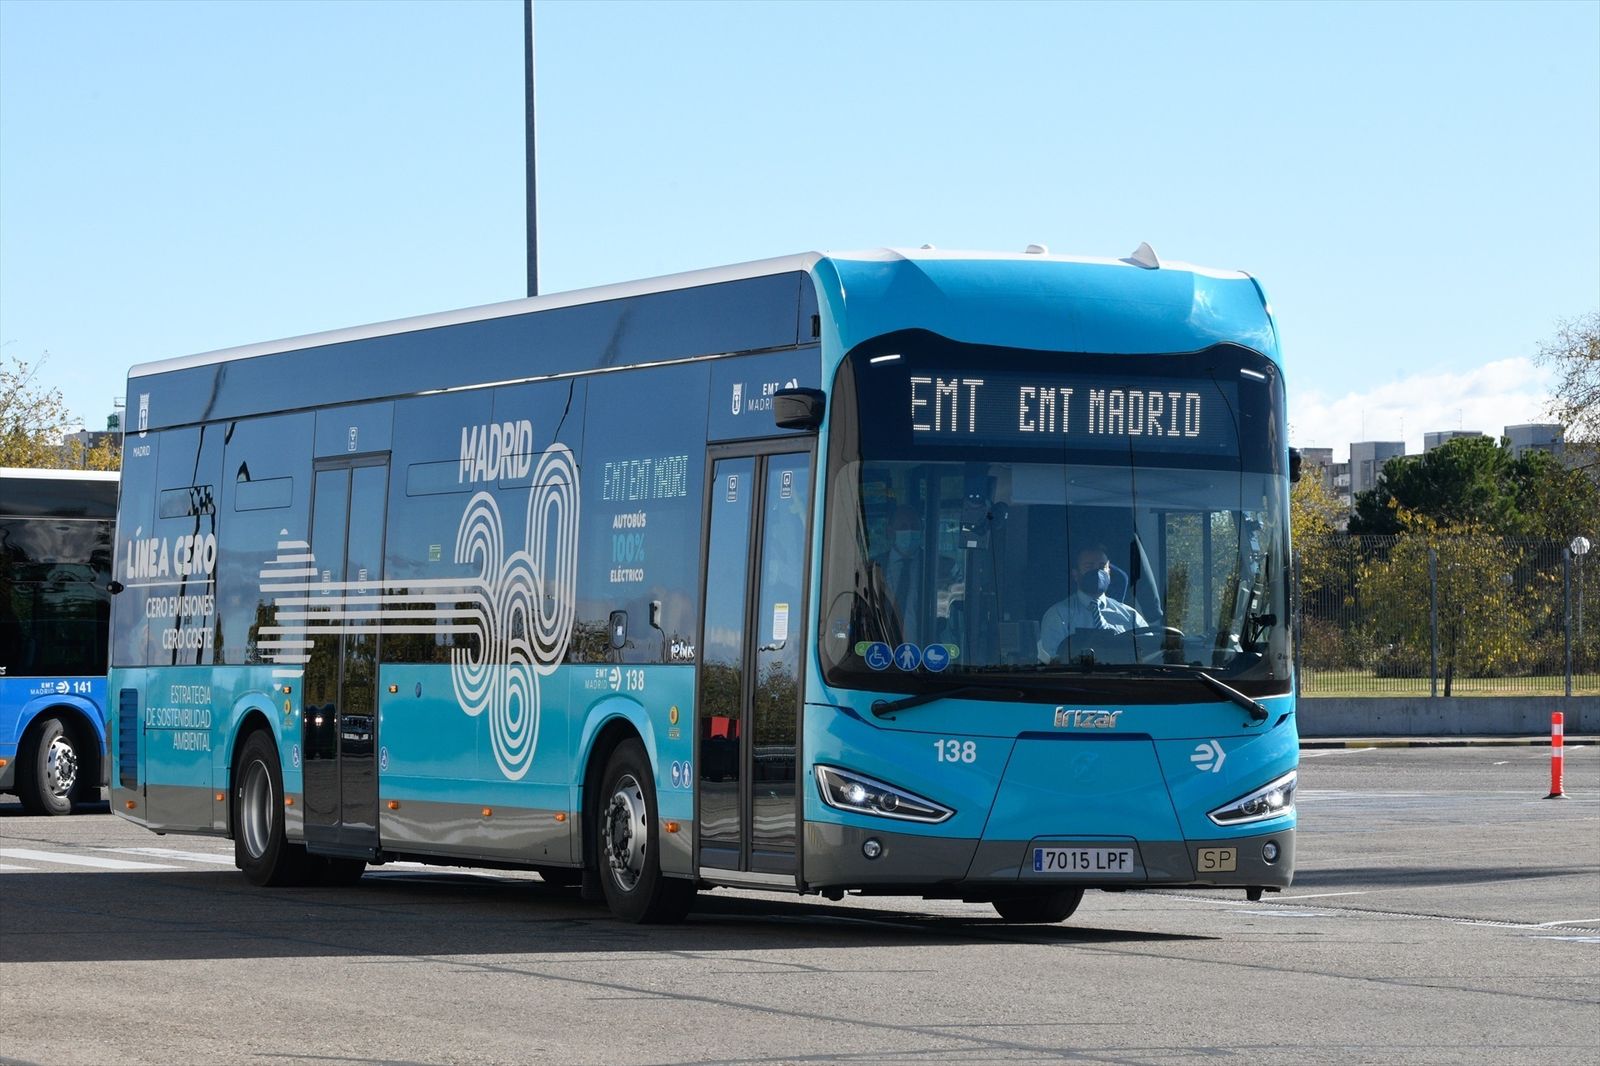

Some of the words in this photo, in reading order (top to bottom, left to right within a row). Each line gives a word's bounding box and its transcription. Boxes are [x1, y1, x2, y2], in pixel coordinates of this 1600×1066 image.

[763, 382, 780, 396] EMT
[747, 398, 775, 412] MADRI
[911, 376, 984, 432] EMT
[1019, 386, 1073, 433] EMT
[1089, 388, 1201, 437] MADRID
[133, 445, 151, 457] MADRID
[458, 419, 533, 484] MADRID
[612, 510, 647, 529] AUTOBÚS
[126, 525, 170, 579] LÍNEA
[173, 532, 217, 576] CERO
[612, 533, 645, 562] 100%
[610, 565, 644, 583] ELÉCTRICO
[145, 597, 168, 618] CERO
[169, 594, 215, 618] EMISIONES
[162, 627, 184, 650] CERO
[185, 626, 214, 649] COSTE
[595, 668, 608, 678] EMT
[626, 669, 645, 691] 138
[73, 681, 92, 693] 141
[170, 684, 212, 705] ESTRATEGIA
[585, 679, 608, 690] MADRID
[146, 707, 156, 726] DE
[157, 708, 212, 728] SOSTENIBILIDAD
[173, 731, 212, 752] AMBIENTAL
[933, 739, 977, 764] 138
[1046, 851, 1090, 870] 7015
[1096, 851, 1129, 870] LPF
[1203, 851, 1232, 869] SP
